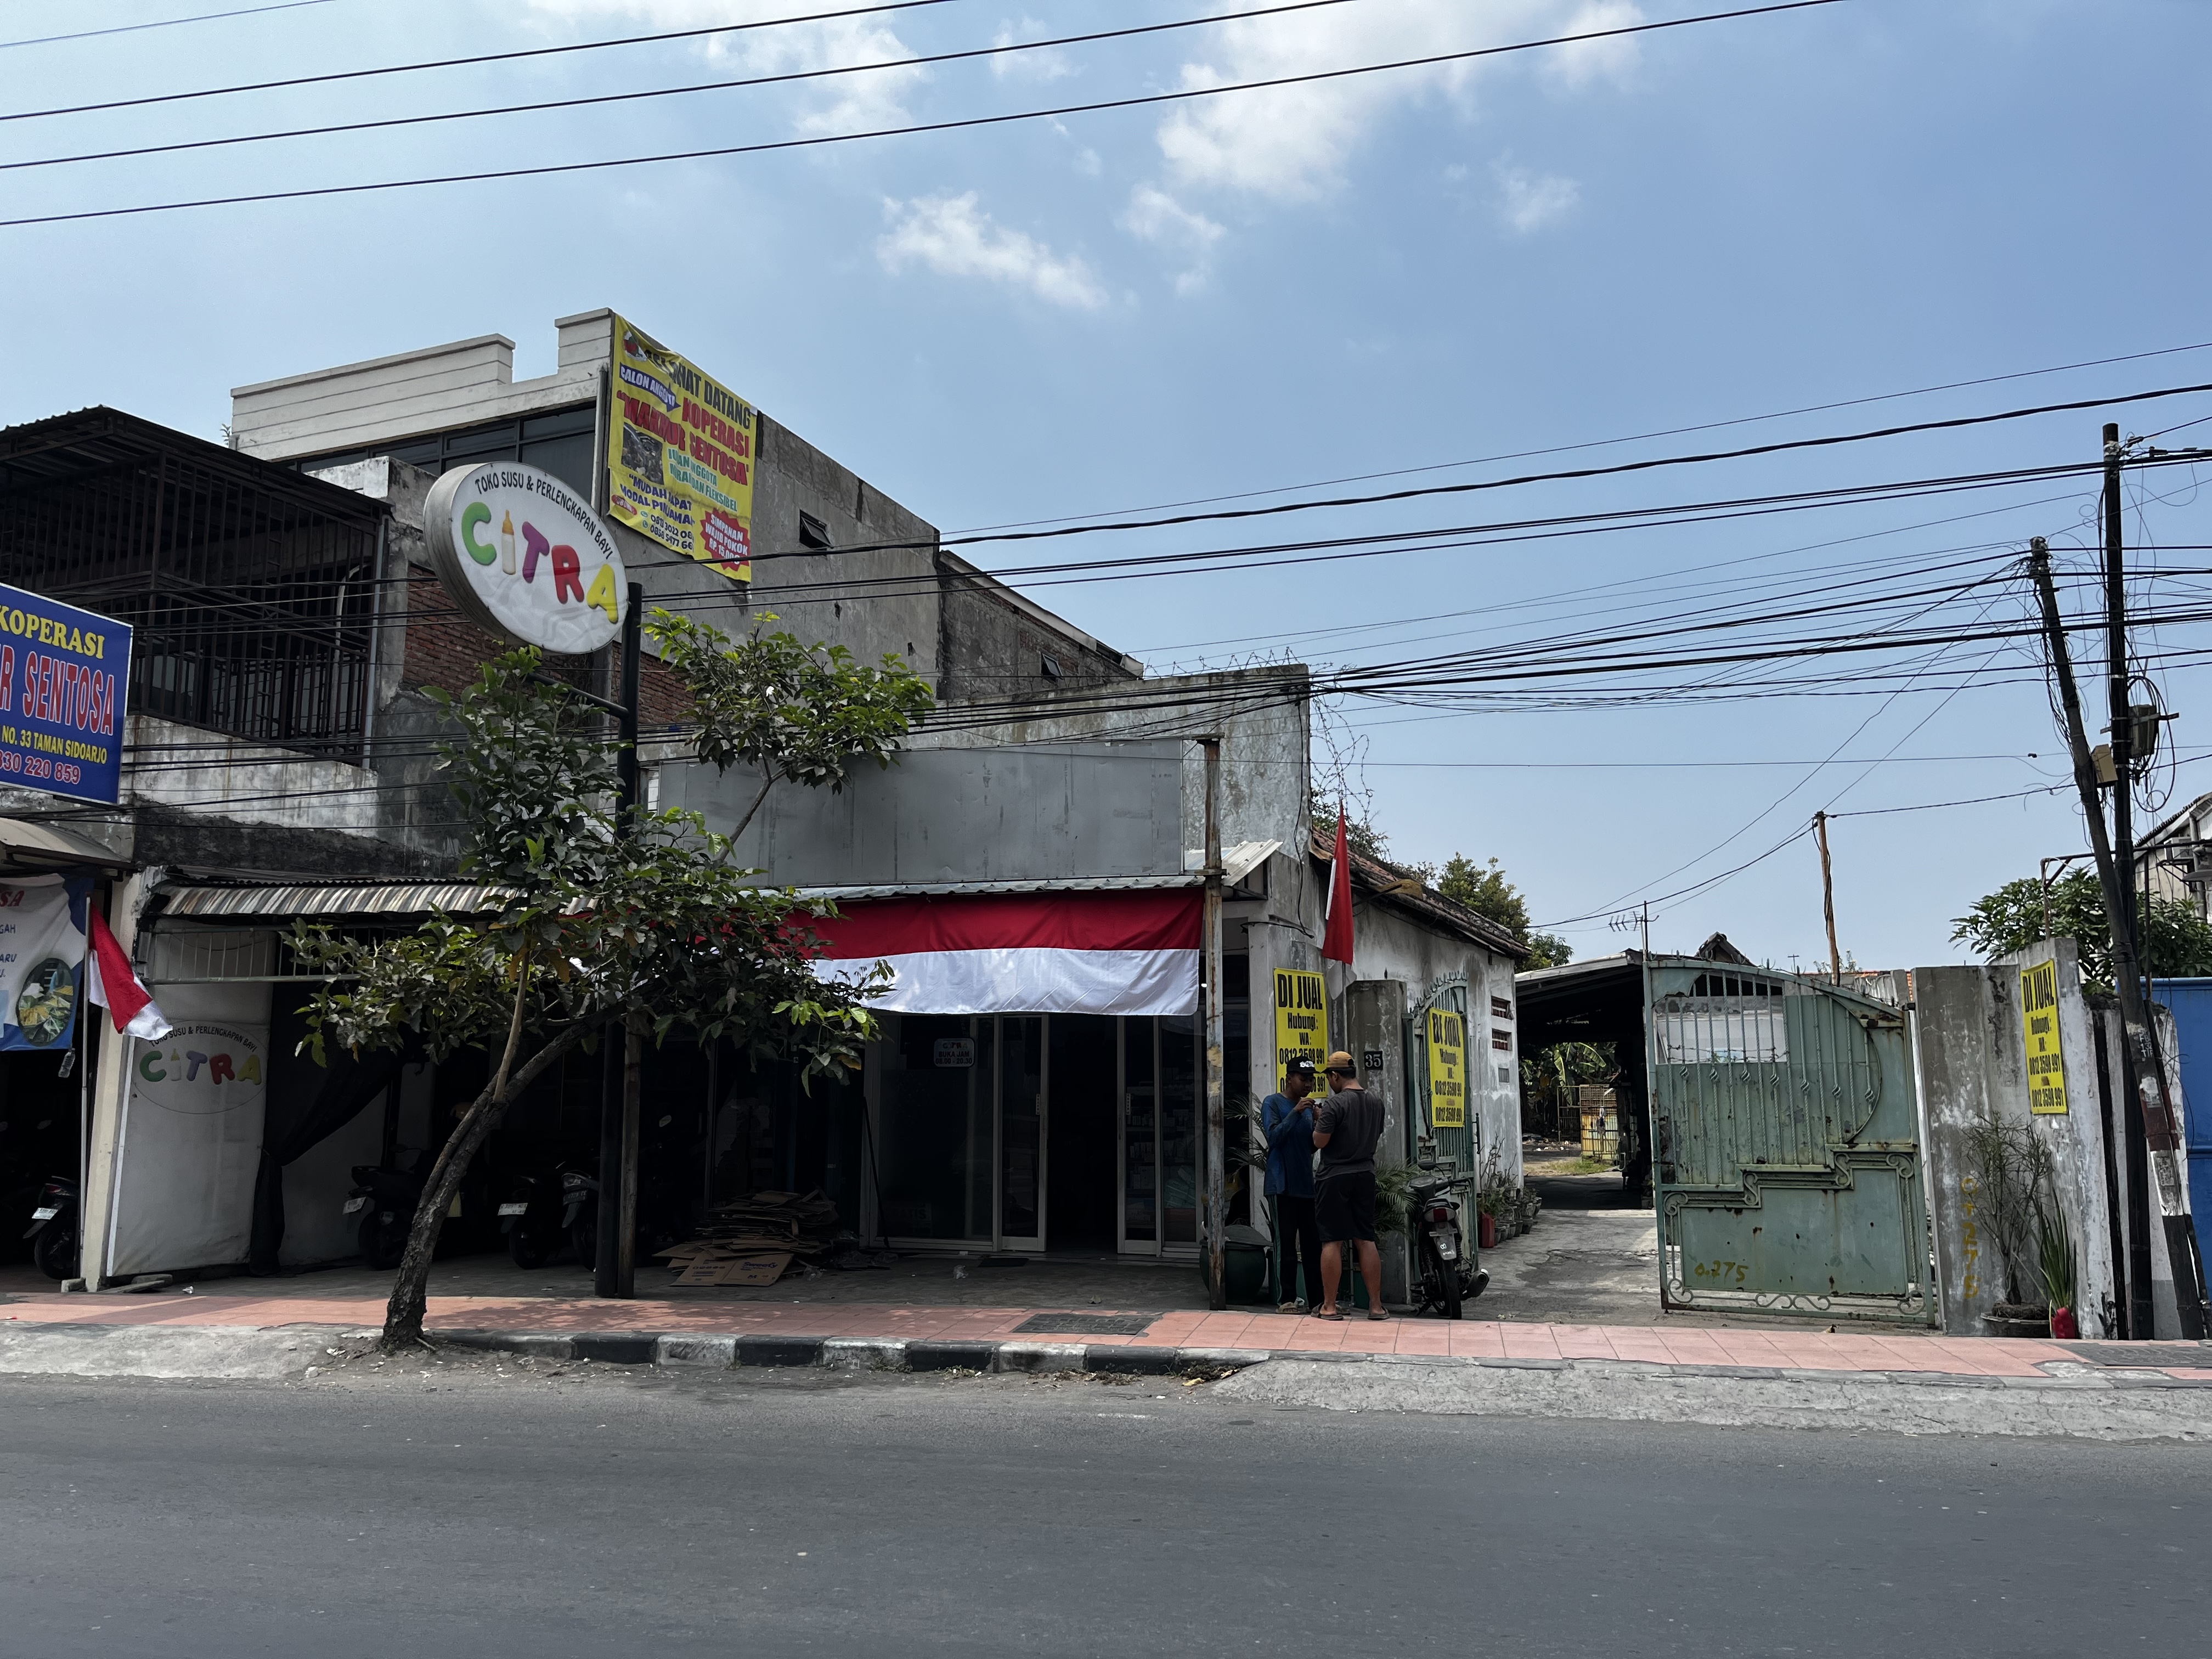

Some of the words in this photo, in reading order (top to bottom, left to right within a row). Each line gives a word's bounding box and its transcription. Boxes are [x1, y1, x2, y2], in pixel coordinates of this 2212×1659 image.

[620, 366, 650, 388] CALON
[704, 380, 751, 430] DATANG
[682, 397, 750, 459] KOPERASI
[475, 473, 500, 495] TOKO
[501, 471, 524, 488] SUSU
[526, 475, 534, 491] &
[536, 478, 596, 536] PERLENGKAPAN
[594, 530, 613, 560] BAYI
[706, 484, 737, 512] FLEKSIBEL
[705, 522, 724, 544] WAJIB
[724, 536, 748, 556] POKOK
[710, 514, 743, 542] SIMPANAN
[461, 501, 619, 624] CITRA
[22, 651, 115, 736] SENTOSA
[2, 725, 18, 745] NO.
[20, 729, 32, 748] 33
[33, 732, 64, 756] TAMAN
[65, 739, 108, 765] SIDOARJO
[24, 755, 52, 779] 220
[54, 762, 81, 785] 859
[1277, 974, 1294, 1008] DI
[1297, 975, 1323, 1010] JUAL
[2023, 974, 2034, 1013] DI
[2033, 967, 2054, 1011] JUAL
[170, 1026, 187, 1039] SUSU
[195, 1026, 244, 1043] PERLENGKAPAN
[243, 1038, 258, 1053] BAYI
[1432, 1013, 1443, 1045] DI
[1444, 1015, 1461, 1048] JUAL
[139, 1048, 262, 1086] CITRA
[1365, 1054, 1381, 1068] 35
[1317, 1076, 1326, 1092] 991
